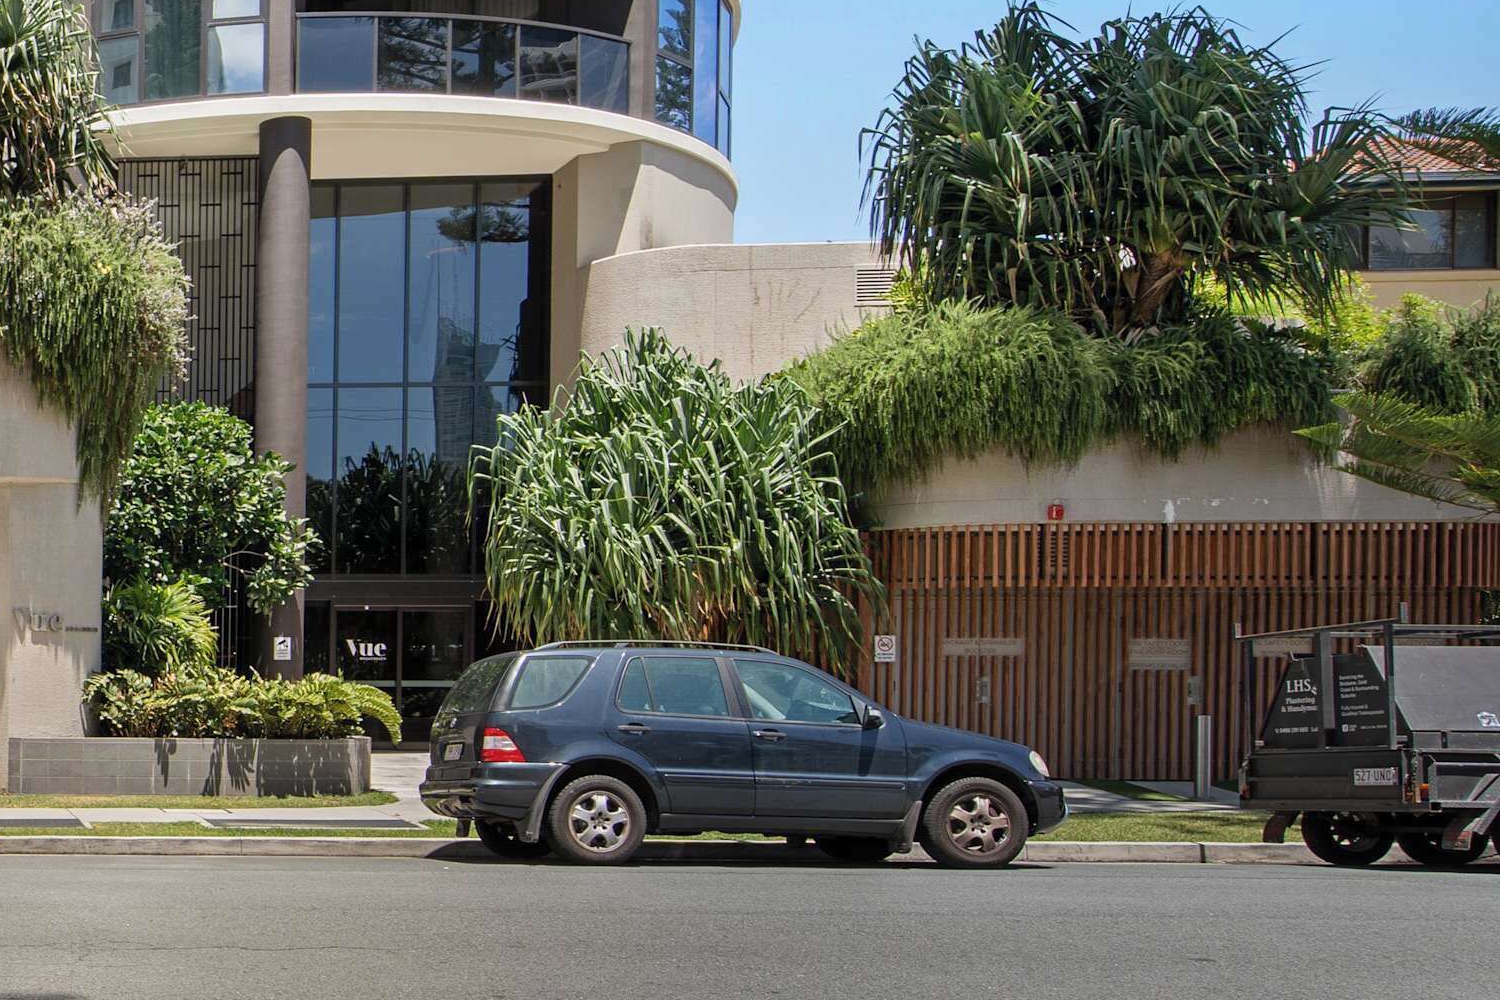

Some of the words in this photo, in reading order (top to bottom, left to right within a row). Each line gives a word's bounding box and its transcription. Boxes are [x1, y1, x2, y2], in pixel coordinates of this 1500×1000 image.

[12, 608, 63, 632] Vue
[346, 639, 387, 656] Vue
[1286, 678, 1311, 693] LHS
[1356, 770, 1370, 781] 527
